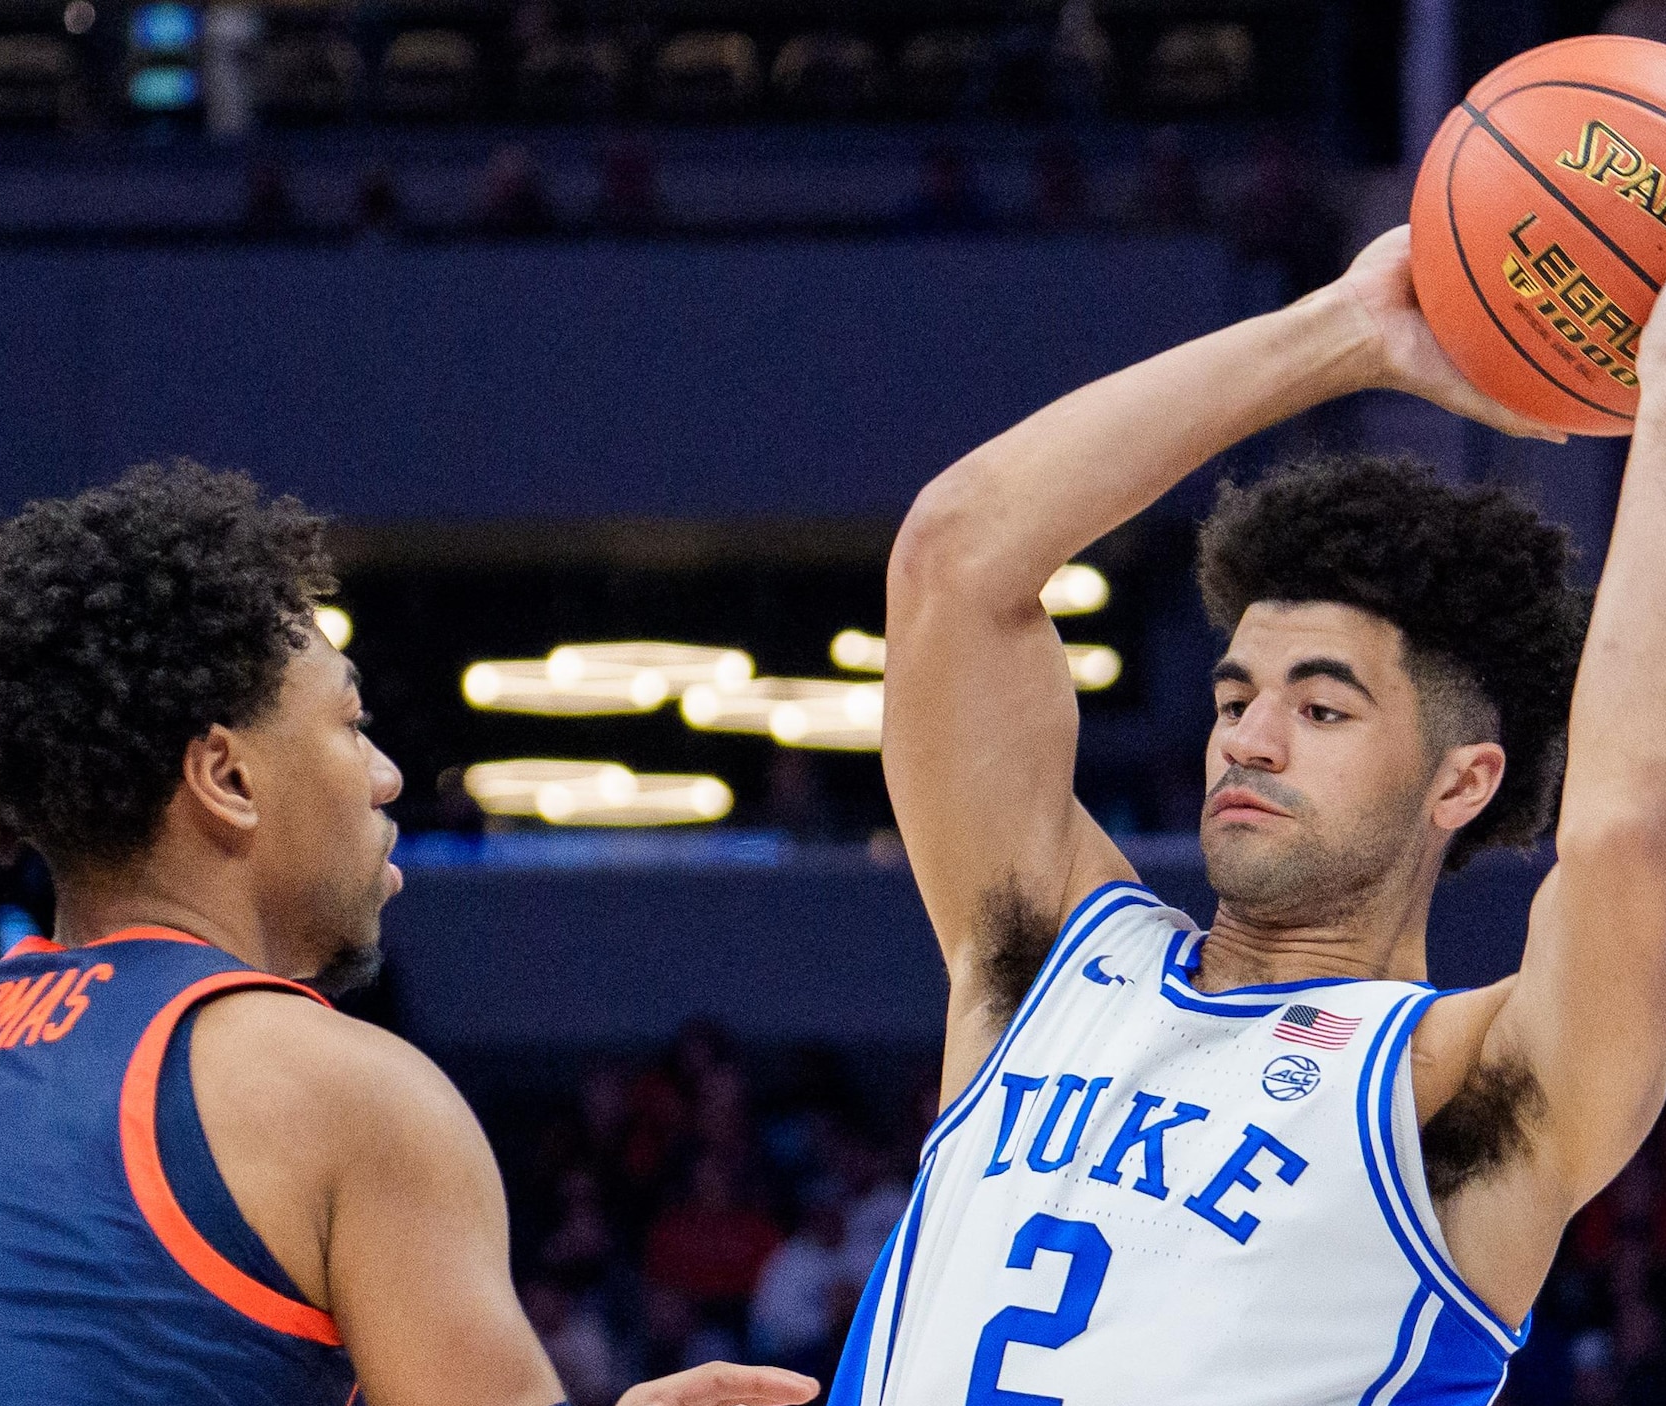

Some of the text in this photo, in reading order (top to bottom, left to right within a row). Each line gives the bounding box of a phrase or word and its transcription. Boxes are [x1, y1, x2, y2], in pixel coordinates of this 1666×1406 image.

[1508, 213, 1642, 364] LEGAC
[1271, 1069, 1318, 1085] ACC
[983, 1071, 1309, 1245] DUKE
